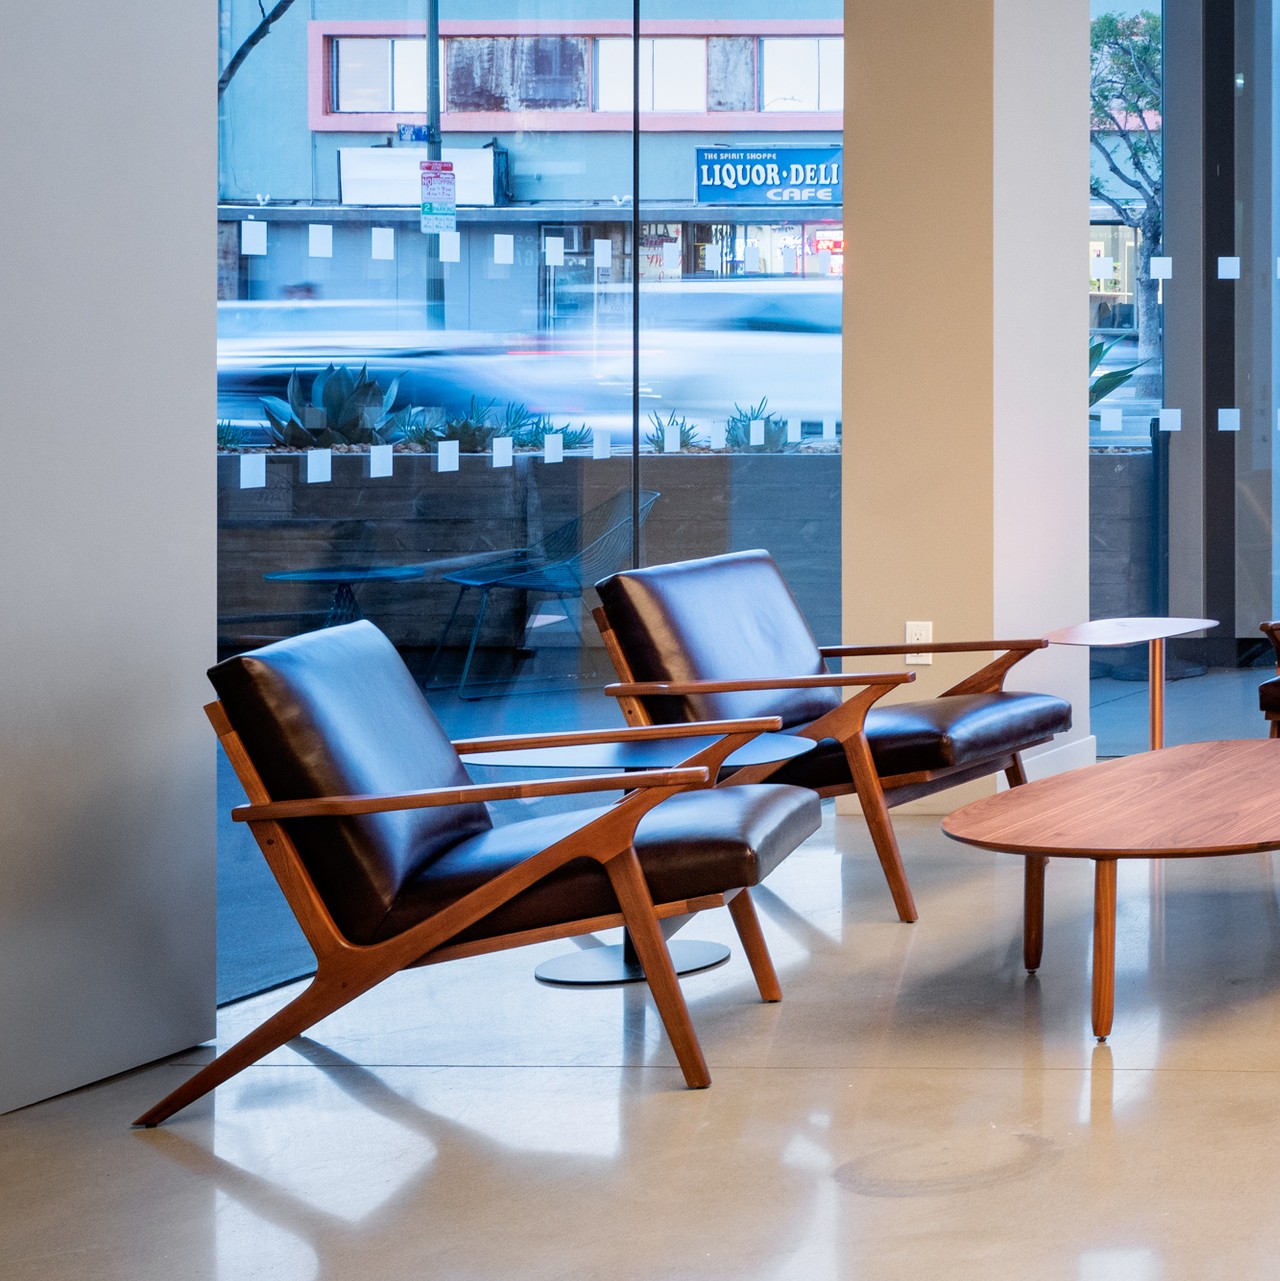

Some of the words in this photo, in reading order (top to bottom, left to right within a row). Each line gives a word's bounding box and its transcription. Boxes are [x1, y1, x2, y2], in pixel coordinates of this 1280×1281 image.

[701, 164, 780, 188] LIQUOR
[790, 164, 838, 184] DELI
[766, 188, 832, 200] CAFE
